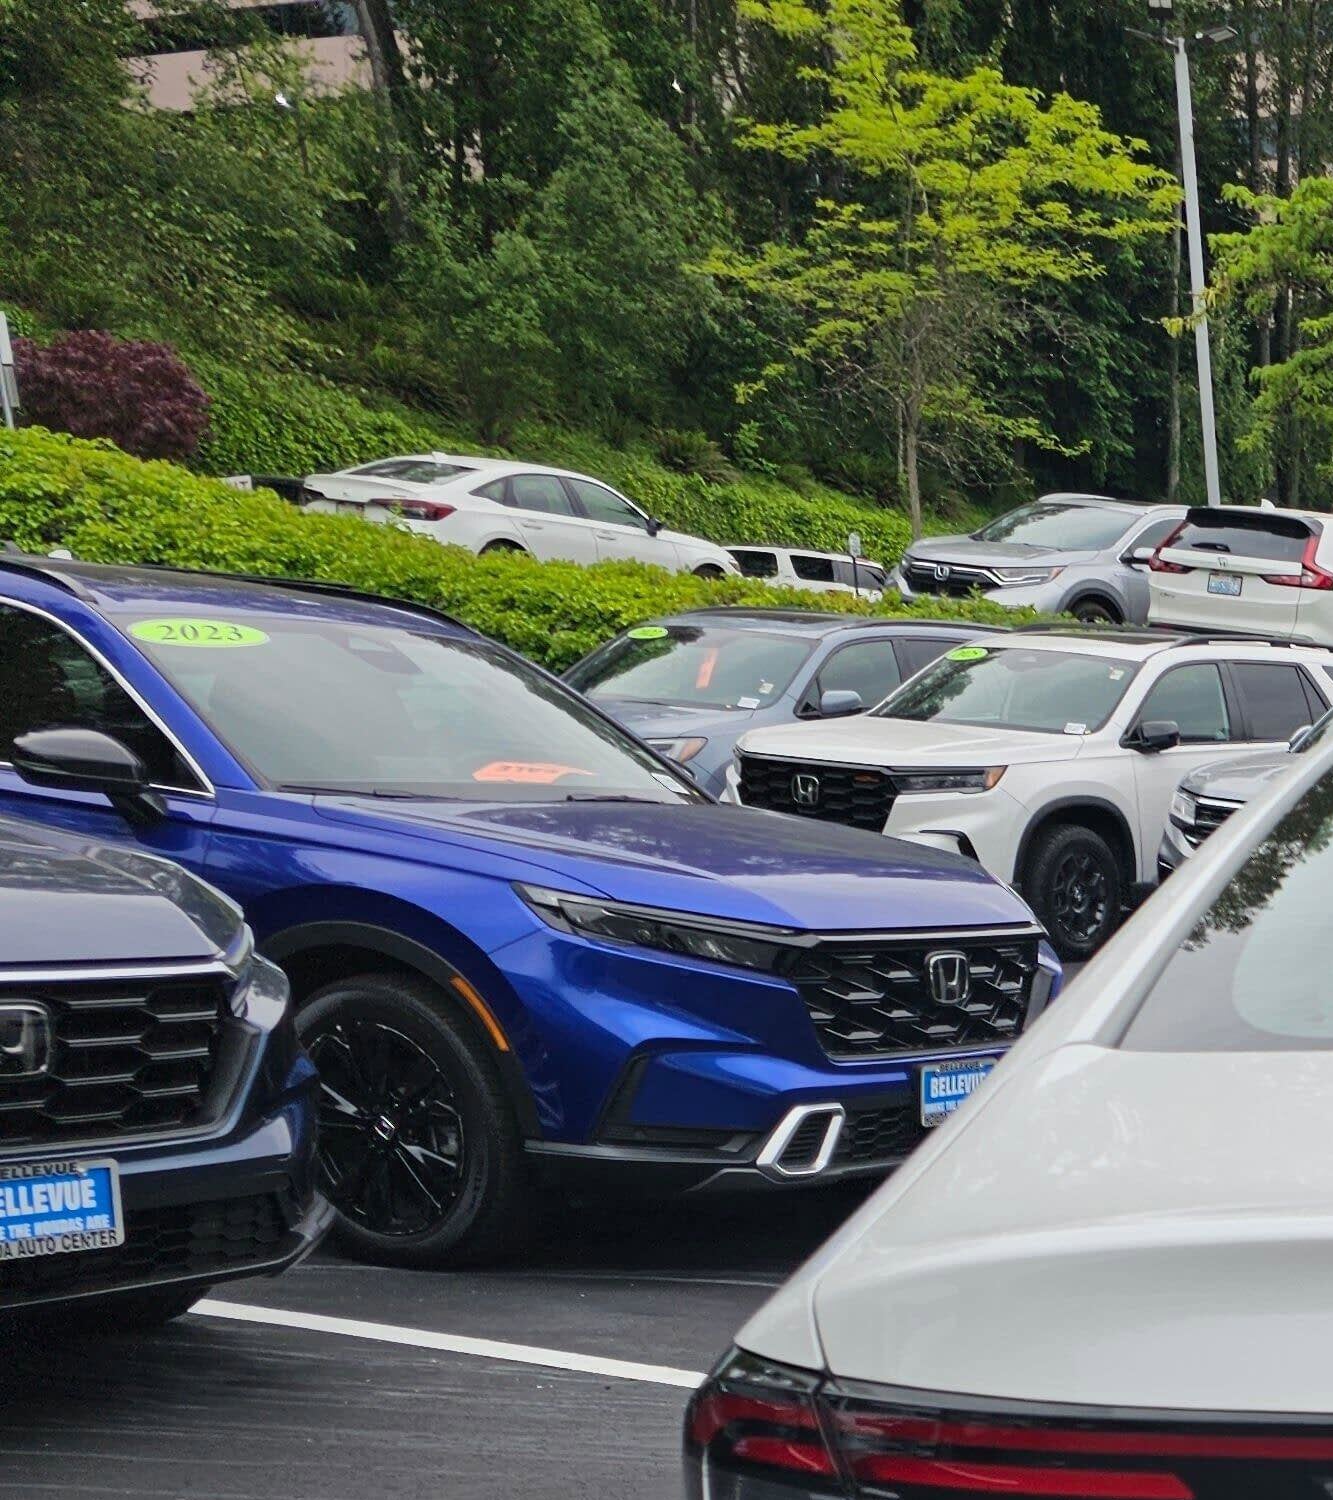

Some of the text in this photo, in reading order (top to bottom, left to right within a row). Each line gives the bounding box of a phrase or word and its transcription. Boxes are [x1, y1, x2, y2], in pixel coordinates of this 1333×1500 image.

[156, 625, 243, 641] 2023
[0, 1162, 77, 1178] ELLEVUE
[0, 1179, 97, 1218] LLEVUE
[17, 1235, 57, 1255] AUTO
[61, 1230, 117, 1250] CENTER
